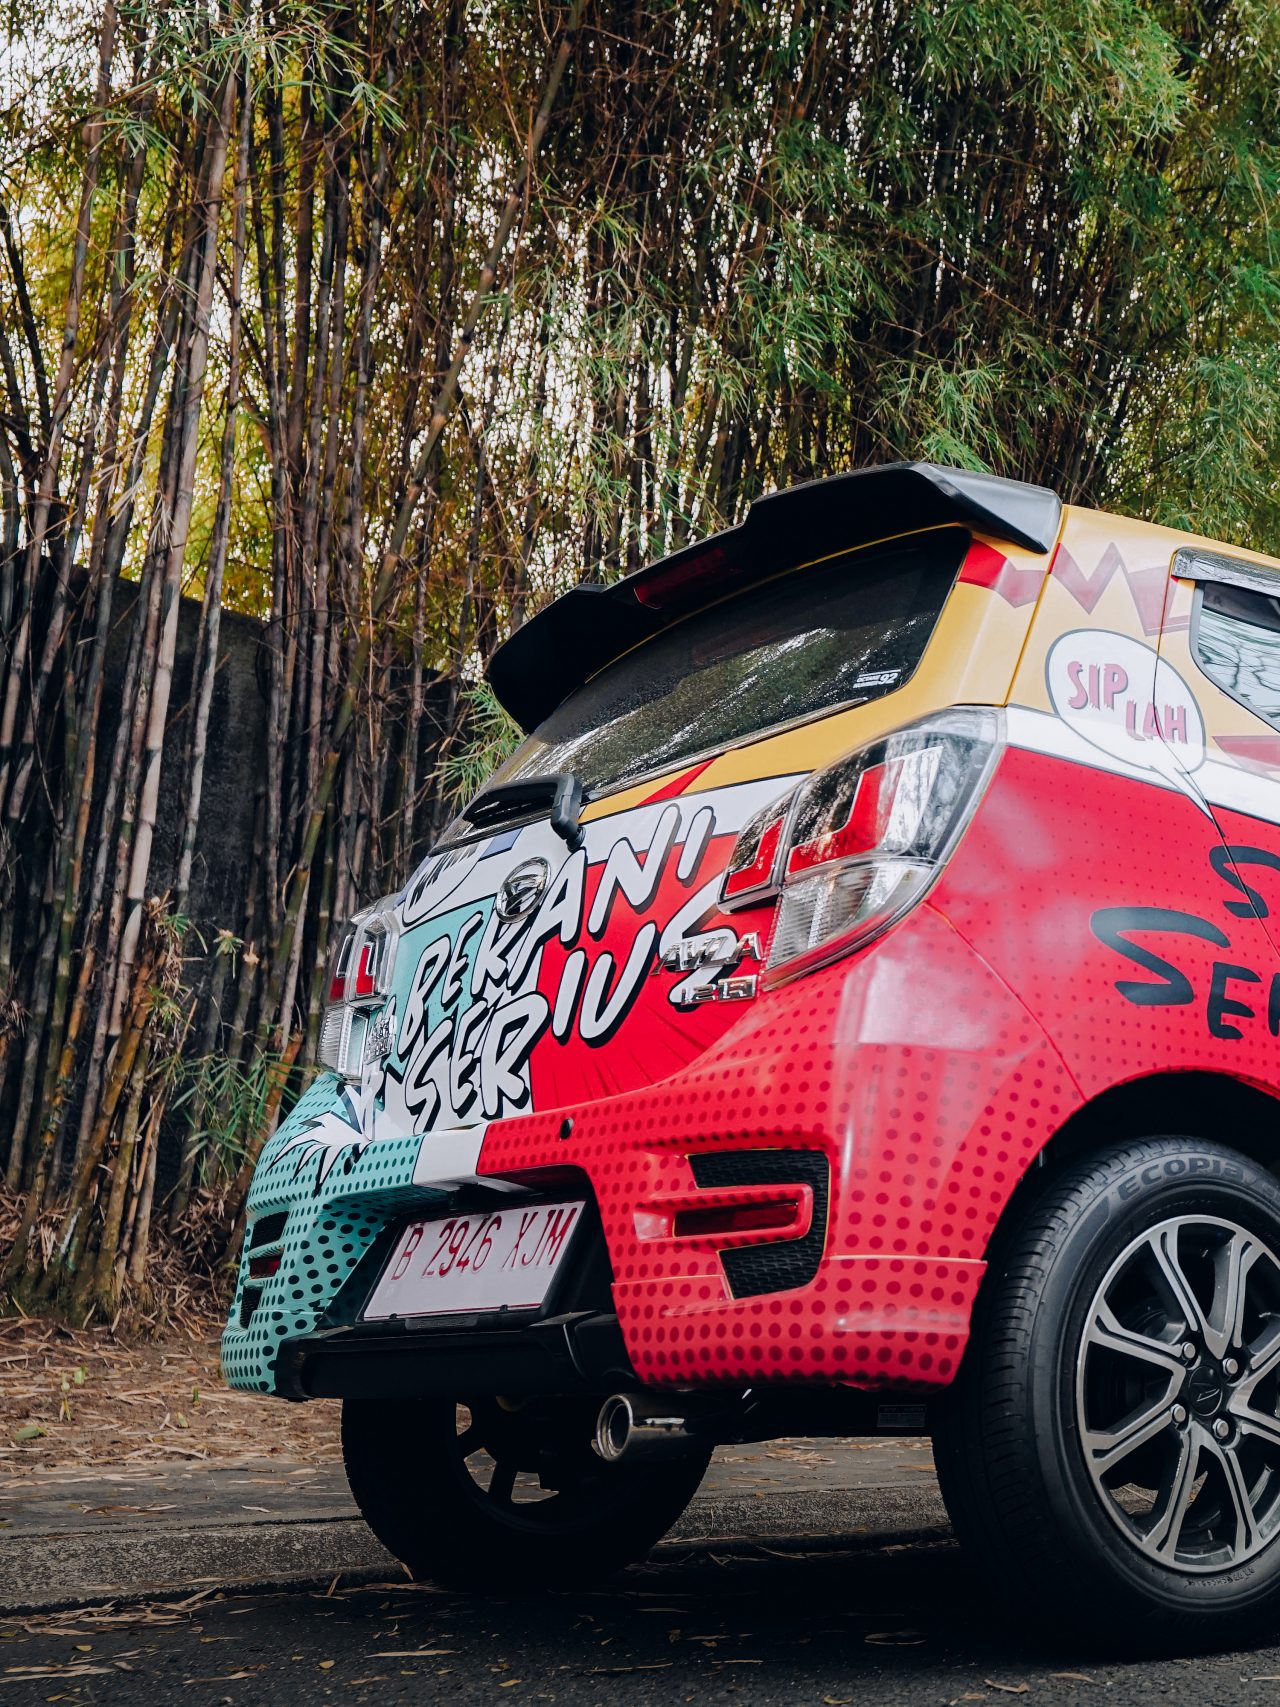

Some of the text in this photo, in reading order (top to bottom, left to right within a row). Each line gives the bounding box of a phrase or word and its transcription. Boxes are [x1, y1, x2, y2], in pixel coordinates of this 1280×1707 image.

[878, 672, 899, 685] 92
[1067, 661, 1128, 712] SIP
[1125, 700, 1188, 744] LAH
[398, 803, 716, 1061] BERANI
[391, 1207, 577, 1281] B 2946 XJM
